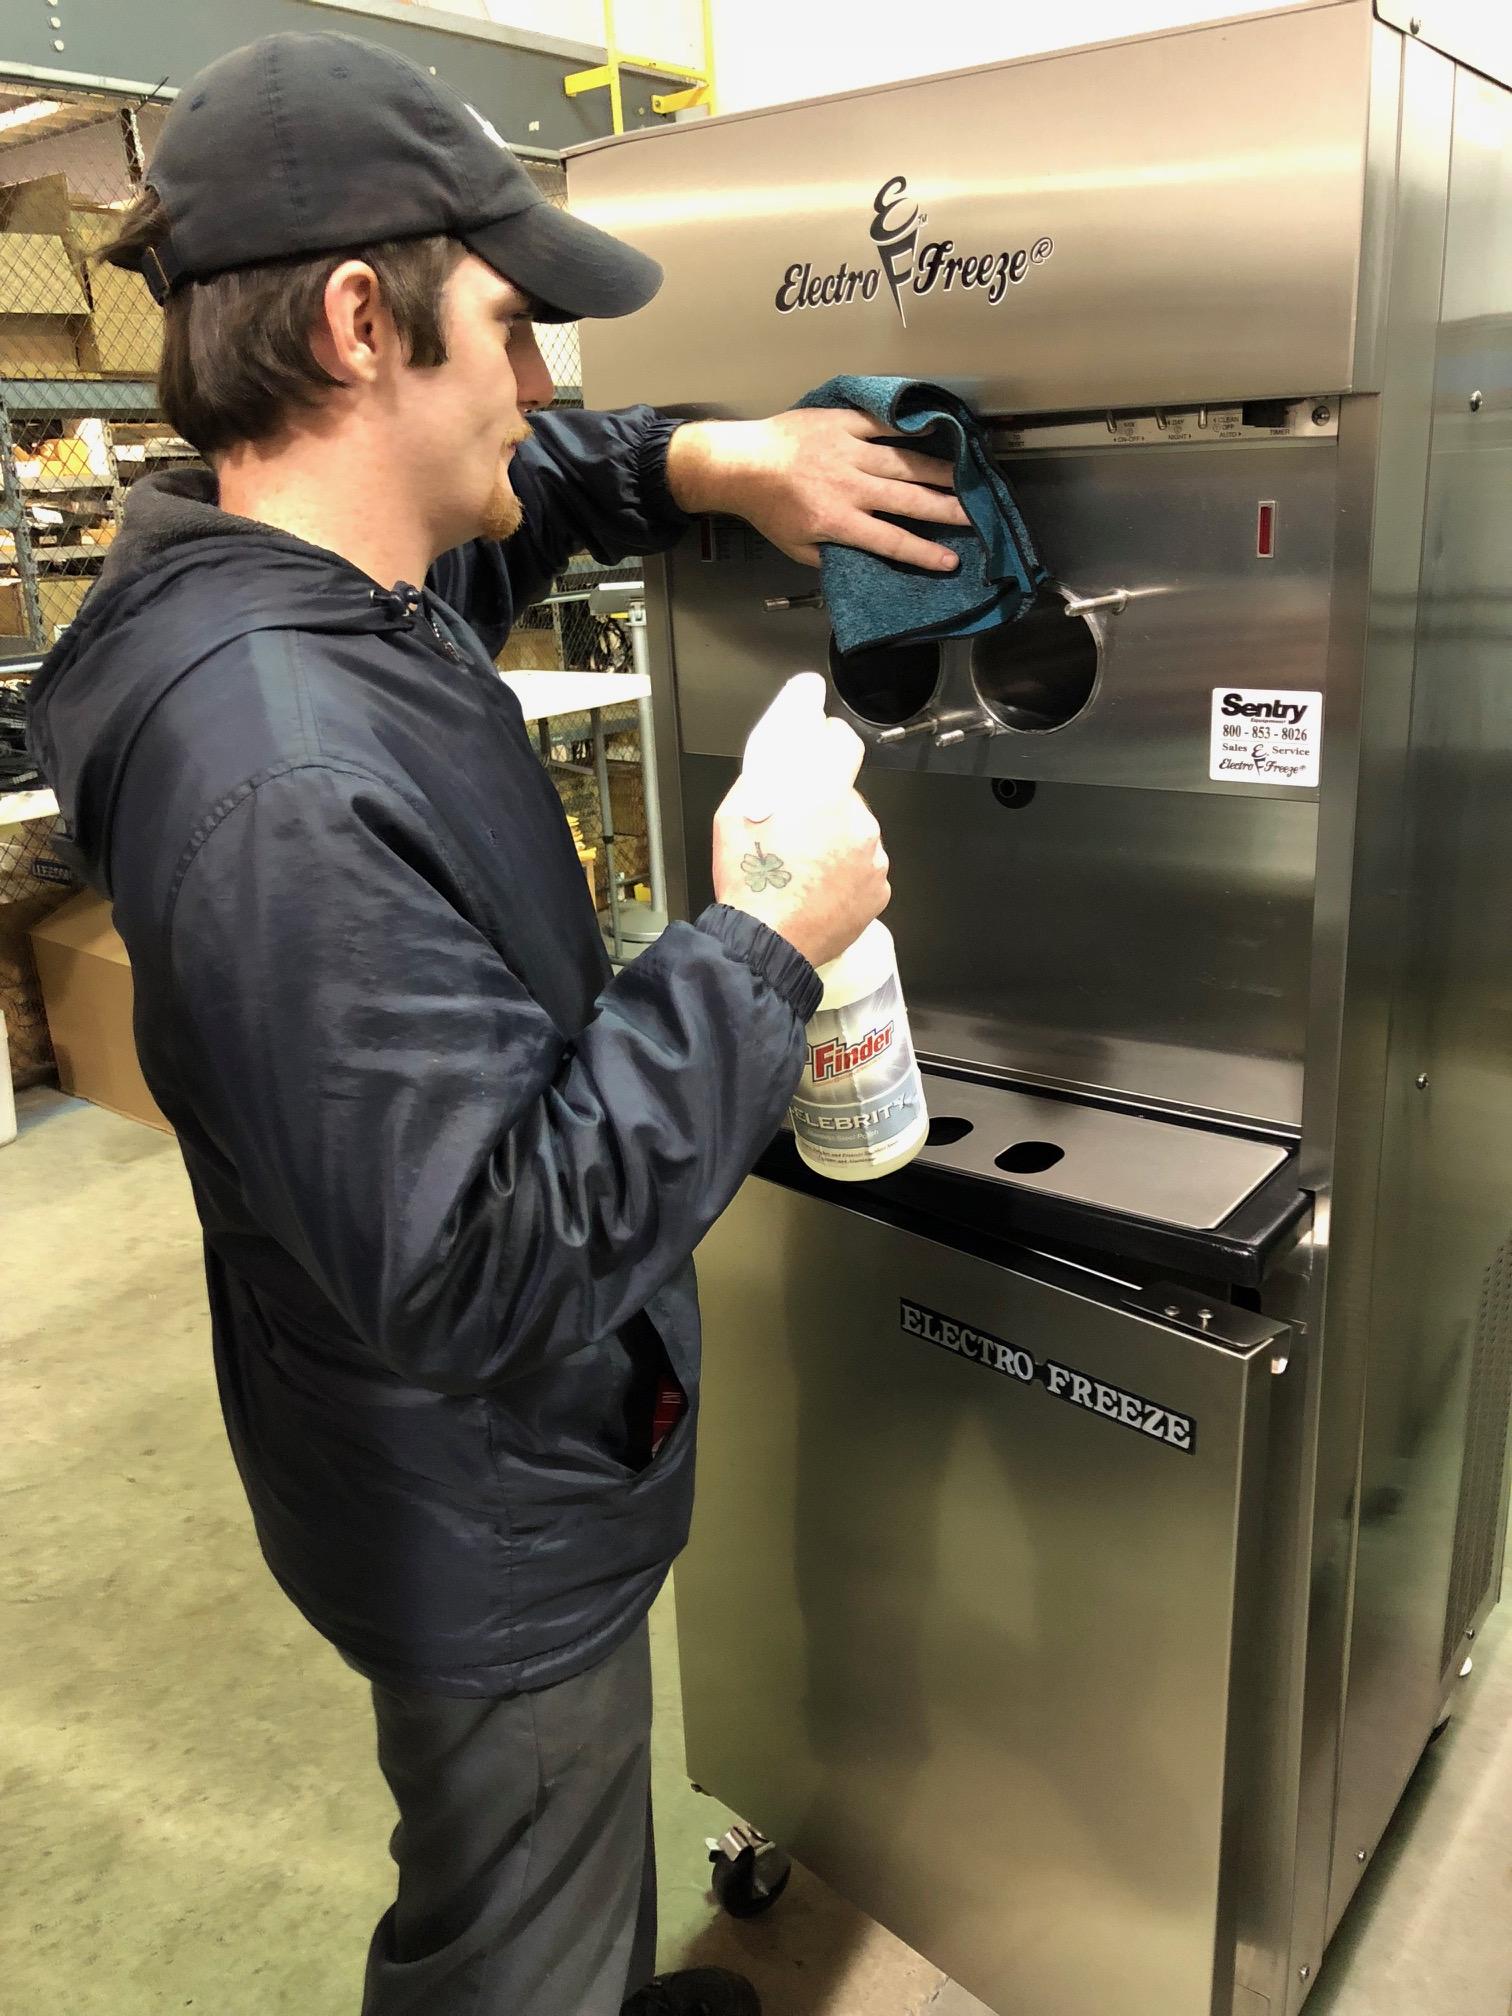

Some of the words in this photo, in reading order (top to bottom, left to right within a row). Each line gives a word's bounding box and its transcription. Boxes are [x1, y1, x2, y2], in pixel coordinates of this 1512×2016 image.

[775, 262, 881, 315] Electro
[1221, 693, 1308, 724] Sentry
[1222, 743, 1248, 752] Sales
[1272, 746, 1310, 756] Service
[1223, 725, 1241, 737] 800
[1252, 726, 1270, 739] 853
[1281, 727, 1308, 741] 8026
[1219, 758, 1254, 771] Electro
[813, 1024, 893, 1081] Finder
[791, 1096, 908, 1131] ELEBRITY
[902, 1303, 1035, 1381] ELECTRO
[1047, 1363, 1191, 1449] FREEZE
